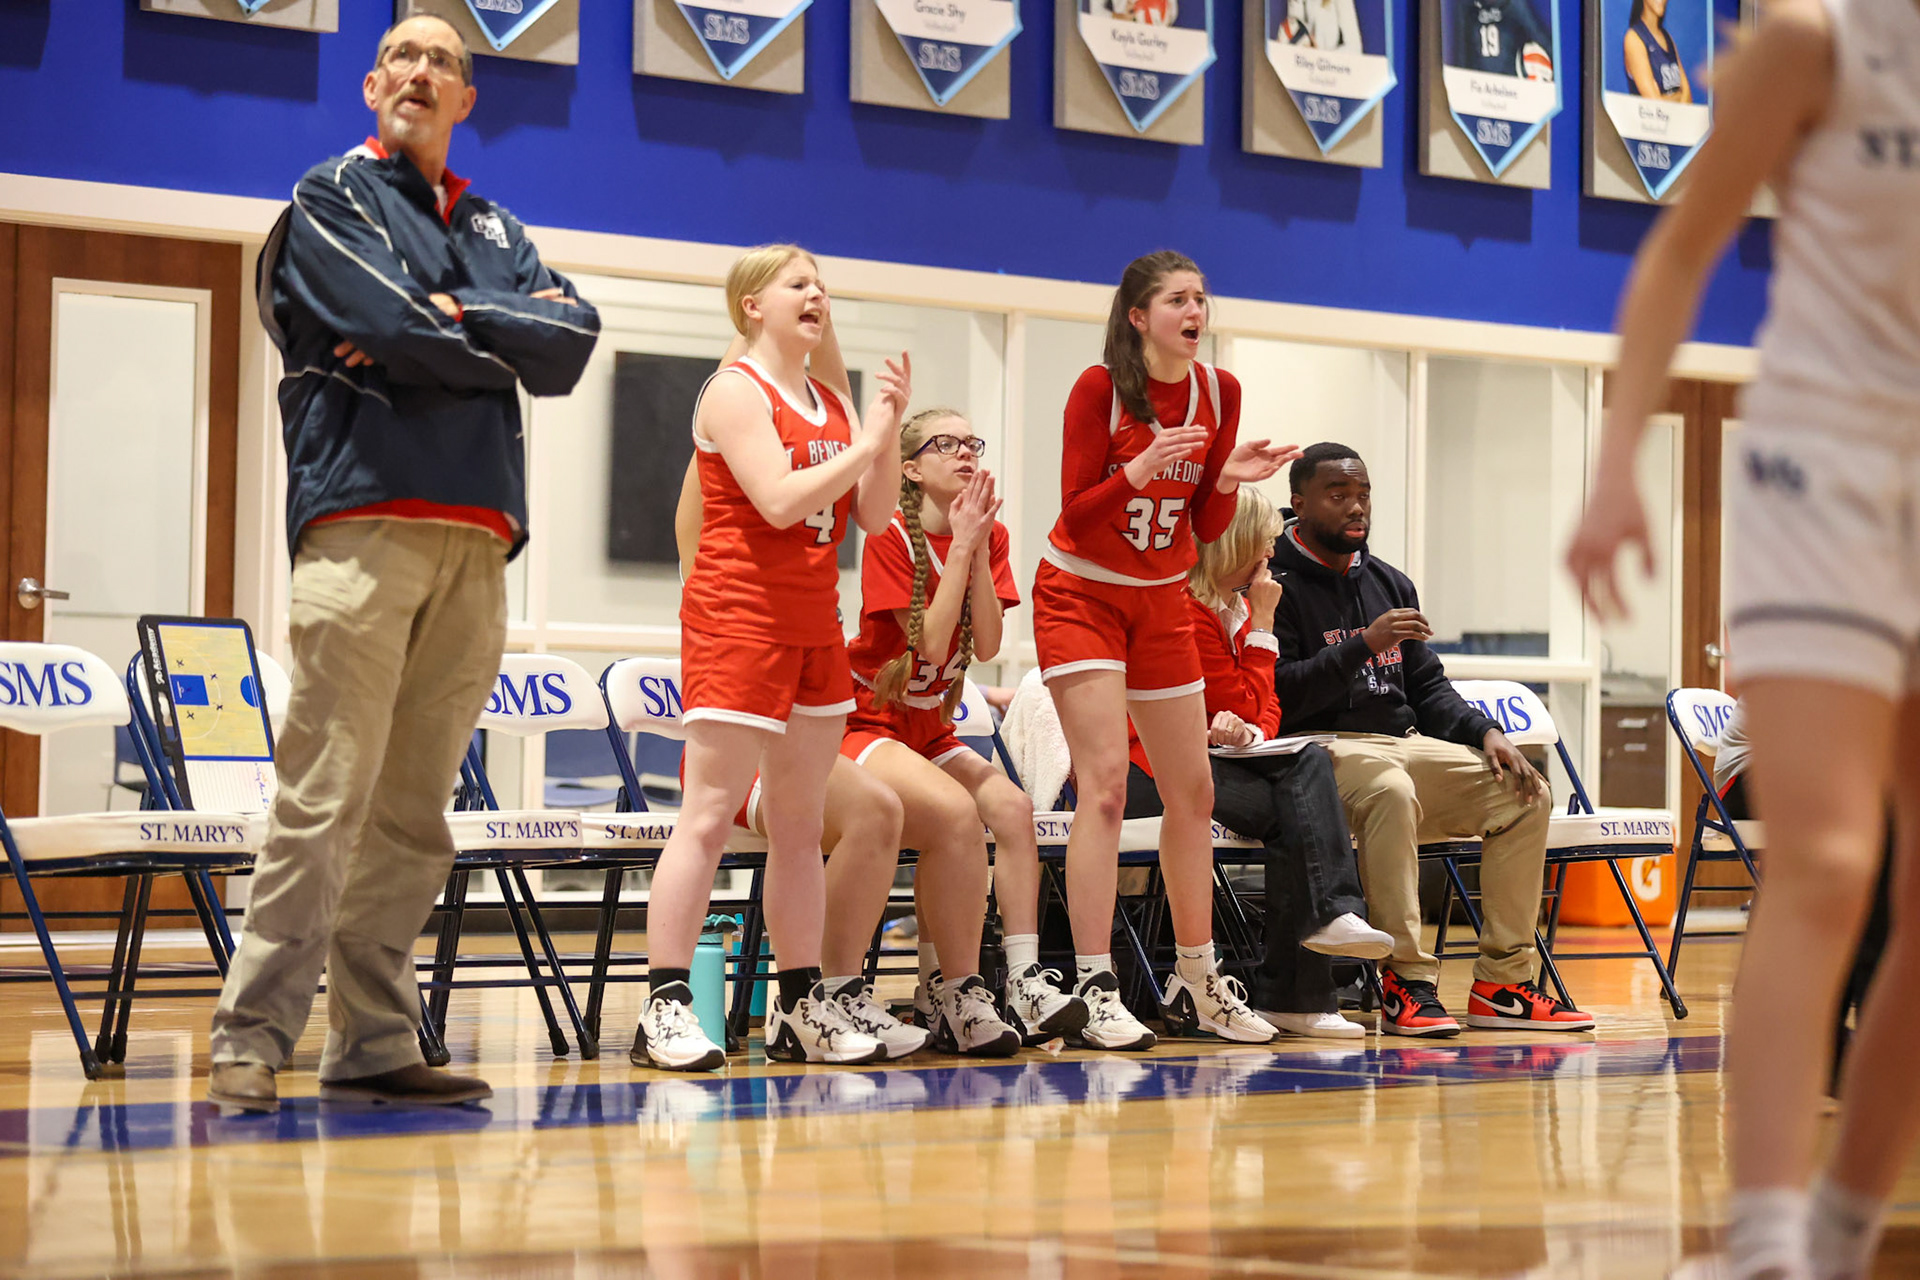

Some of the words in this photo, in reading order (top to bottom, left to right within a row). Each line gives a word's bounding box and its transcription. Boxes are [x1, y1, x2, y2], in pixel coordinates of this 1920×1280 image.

[705, 13, 750, 45] SMS
[1480, 24, 1500, 57] 19
[919, 41, 962, 72] SMS
[1120, 71, 1159, 100] SMS
[1304, 95, 1341, 124] SMS
[1476, 118, 1512, 147] SMS
[1637, 142, 1671, 170] SMS
[1121, 497, 1185, 552] 35
[141, 823, 168, 841] ST.
[173, 824, 244, 843] MARY'S
[486, 822, 511, 839] ST.
[515, 821, 578, 839] MARY'S
[605, 824, 631, 840] ST.
[1037, 821, 1059, 836] ST.
[1600, 821, 1620, 836] ST.
[1624, 821, 1670, 836] MARY'S
[1631, 855, 1661, 901] G
